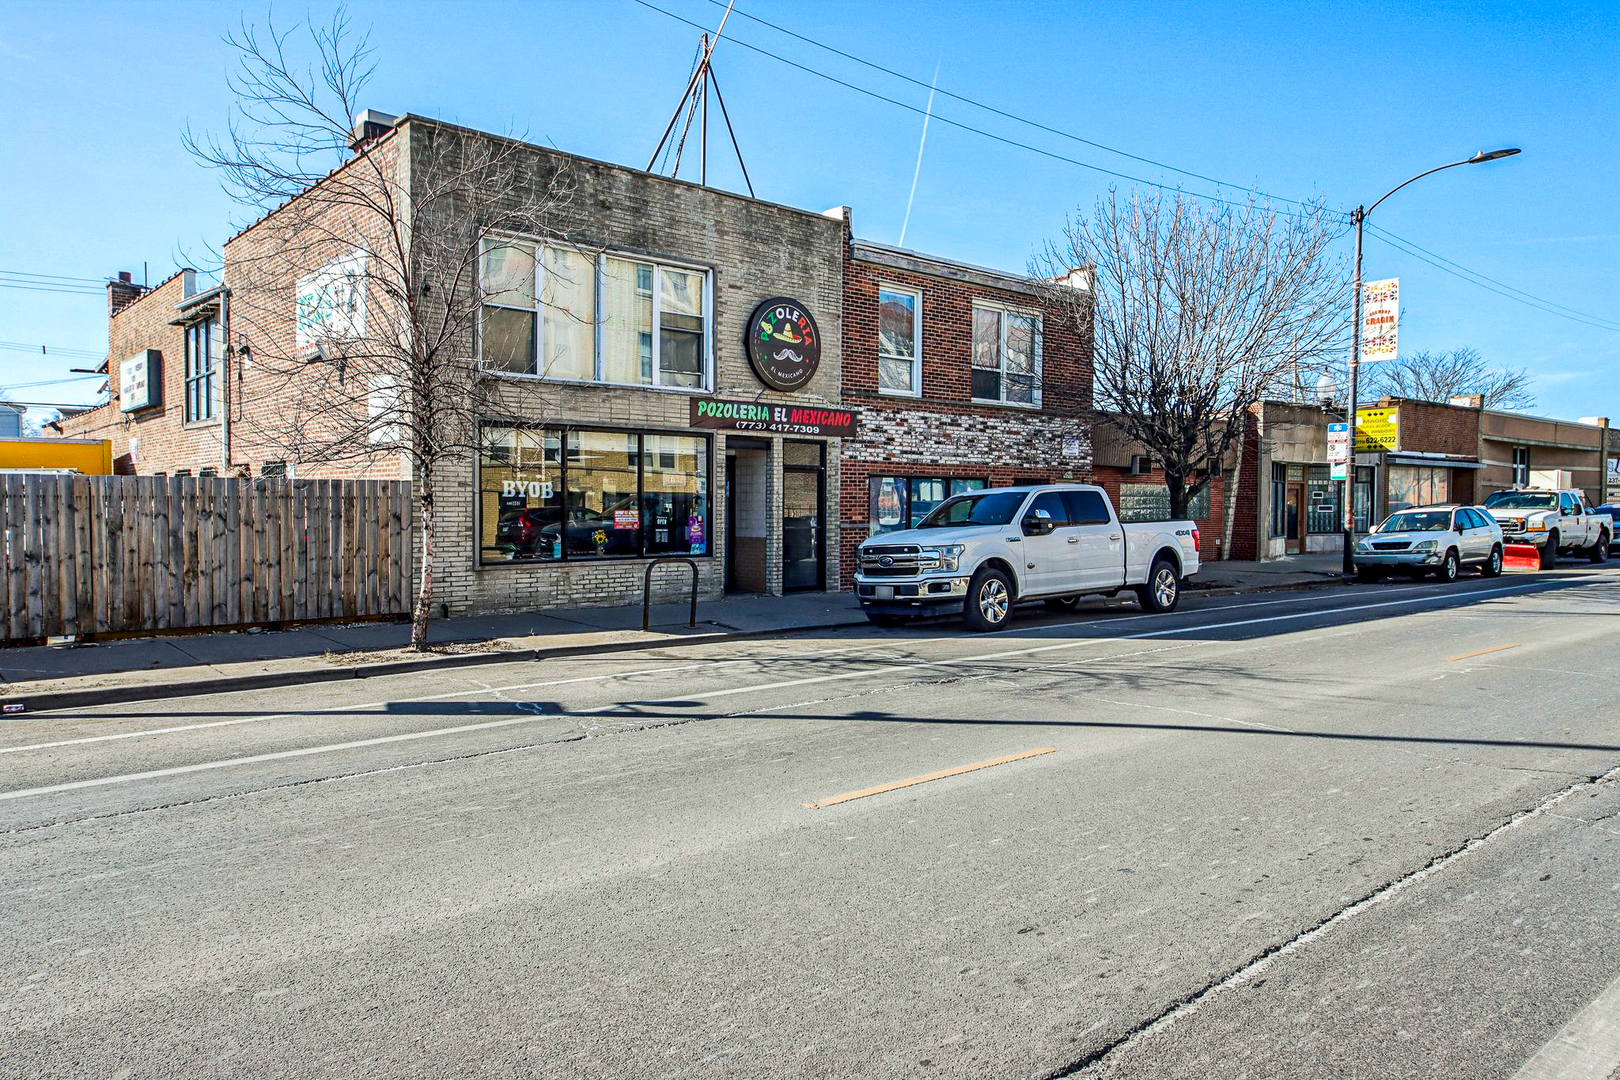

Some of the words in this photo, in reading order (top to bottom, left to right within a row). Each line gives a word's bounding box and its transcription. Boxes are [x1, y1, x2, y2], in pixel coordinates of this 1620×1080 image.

[1365, 315, 1395, 326] CRAGIN
[770, 365, 778, 375] EL
[777, 368, 804, 380] MEXICANO
[697, 400, 770, 422] POZOLERIA
[774, 407, 788, 423] EL
[791, 408, 851, 427] MEXICANO
[735, 420, 767, 431] (773)
[769, 422, 820, 434] 417-7309
[502, 480, 554, 499] BYOB
[656, 518, 667, 526] OPEN
